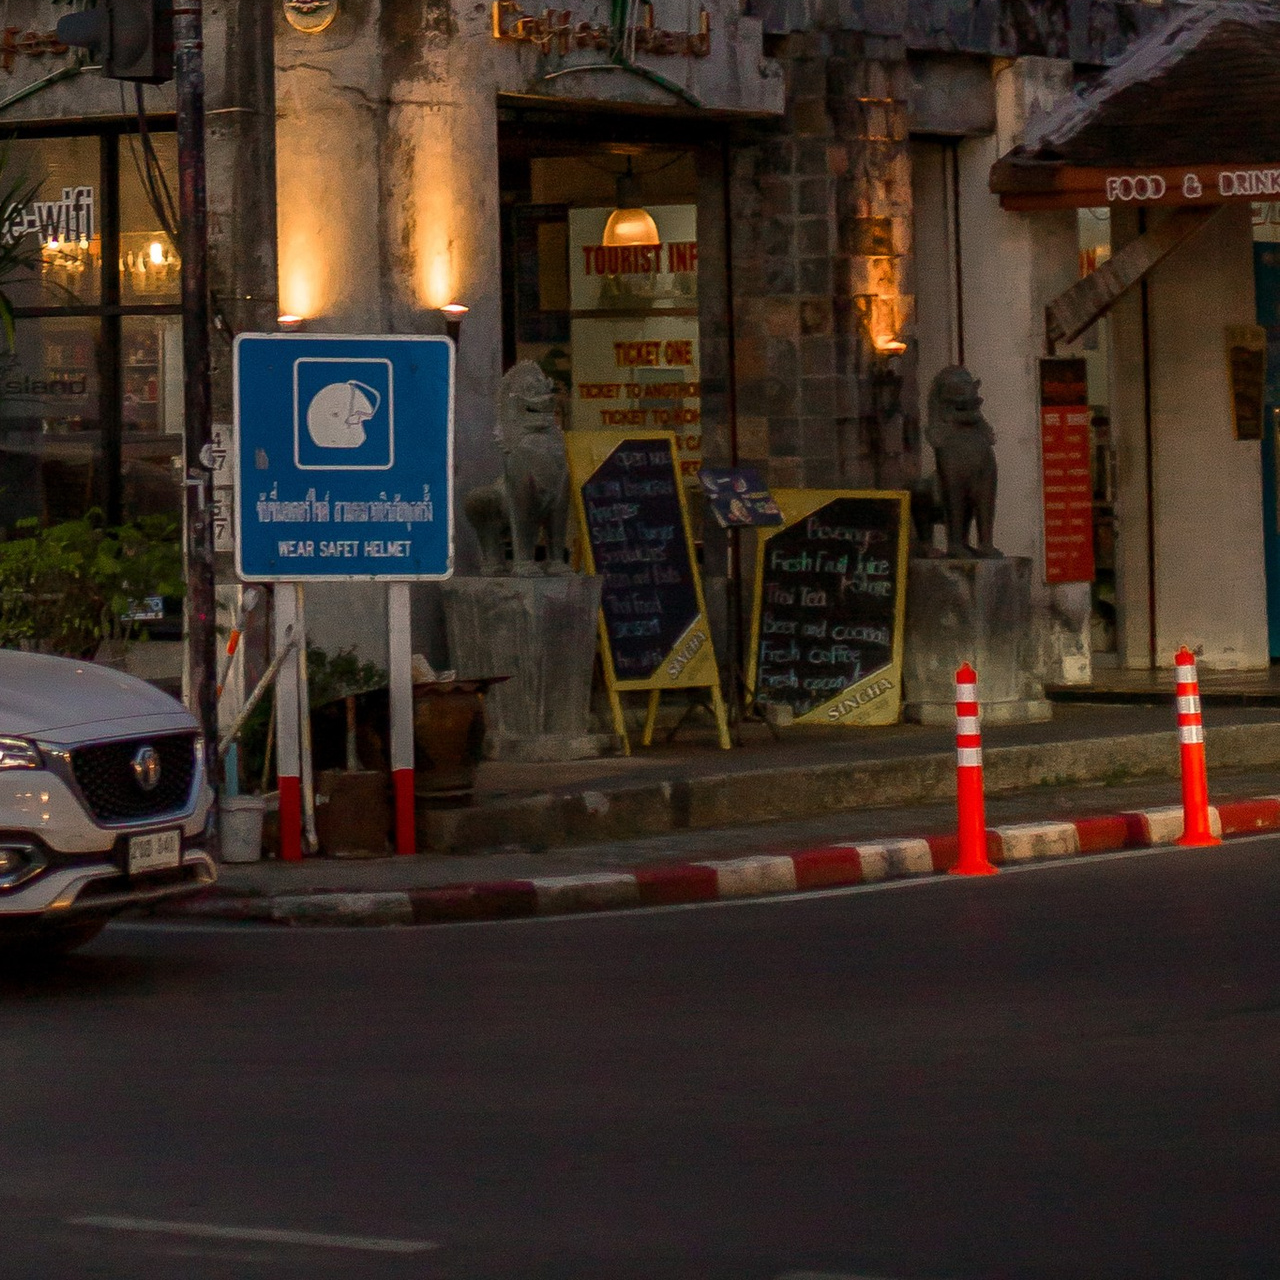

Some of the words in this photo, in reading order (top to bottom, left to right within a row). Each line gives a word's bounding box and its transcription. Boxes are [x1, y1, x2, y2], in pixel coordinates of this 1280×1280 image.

[1106, 174, 1166, 201] FOOD
[1183, 173, 1203, 199] &
[582, 244, 662, 275] TOURIST
[613, 341, 662, 366] TICKET
[664, 340, 693, 365] ONE
[578, 382, 622, 399] TICKET
[624, 382, 642, 399] TO
[600, 410, 647, 426] TICKET
[651, 409, 671, 425] TO
[278, 540, 315, 558] WEAR
[364, 540, 412, 557] HELMET
[826, 676, 895, 722] SINGHA
